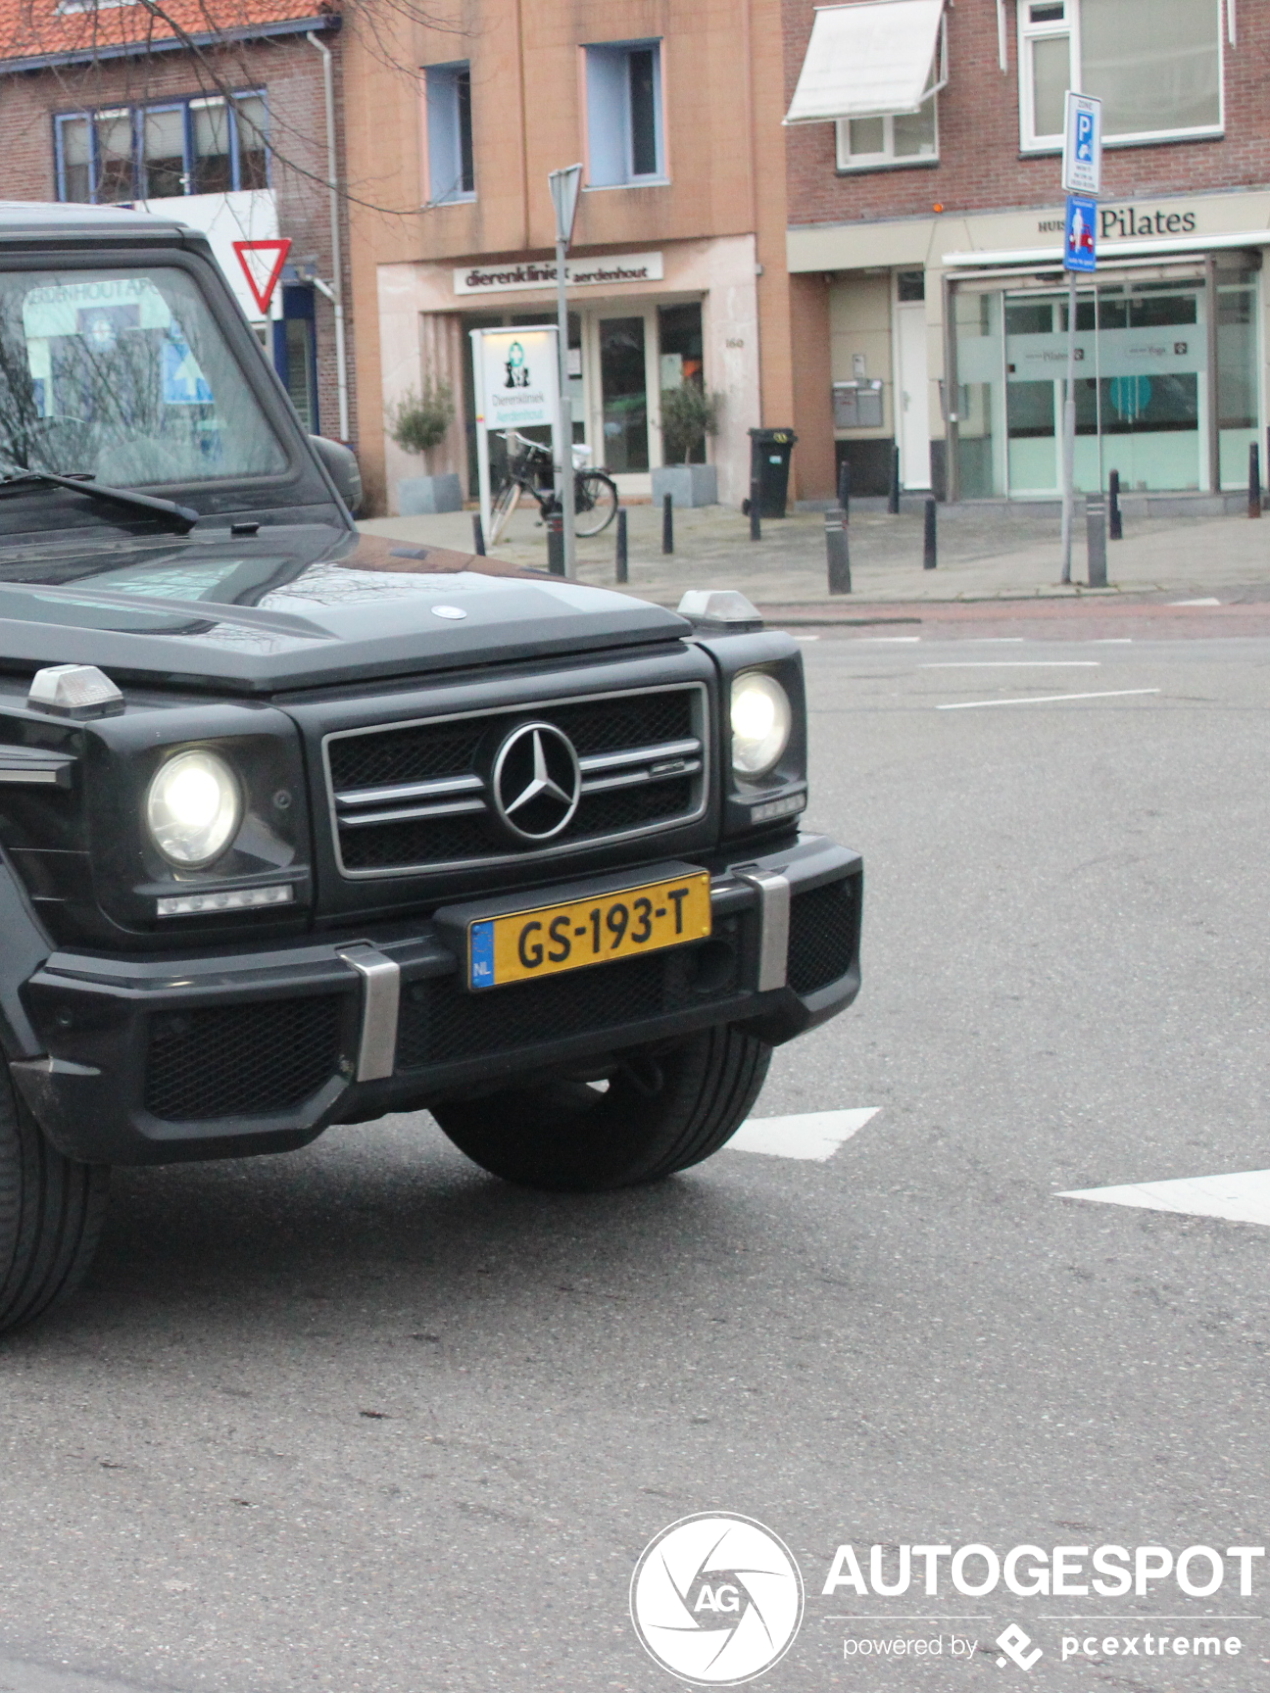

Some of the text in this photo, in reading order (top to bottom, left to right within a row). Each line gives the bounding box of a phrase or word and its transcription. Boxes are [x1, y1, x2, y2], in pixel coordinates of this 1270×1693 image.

[1079, 115, 1090, 141] P
[1100, 208, 1197, 238] Pilates
[573, 265, 648, 283] aerdenhout
[518, 887, 689, 969] GS-193-T
[473, 961, 491, 977] NL
